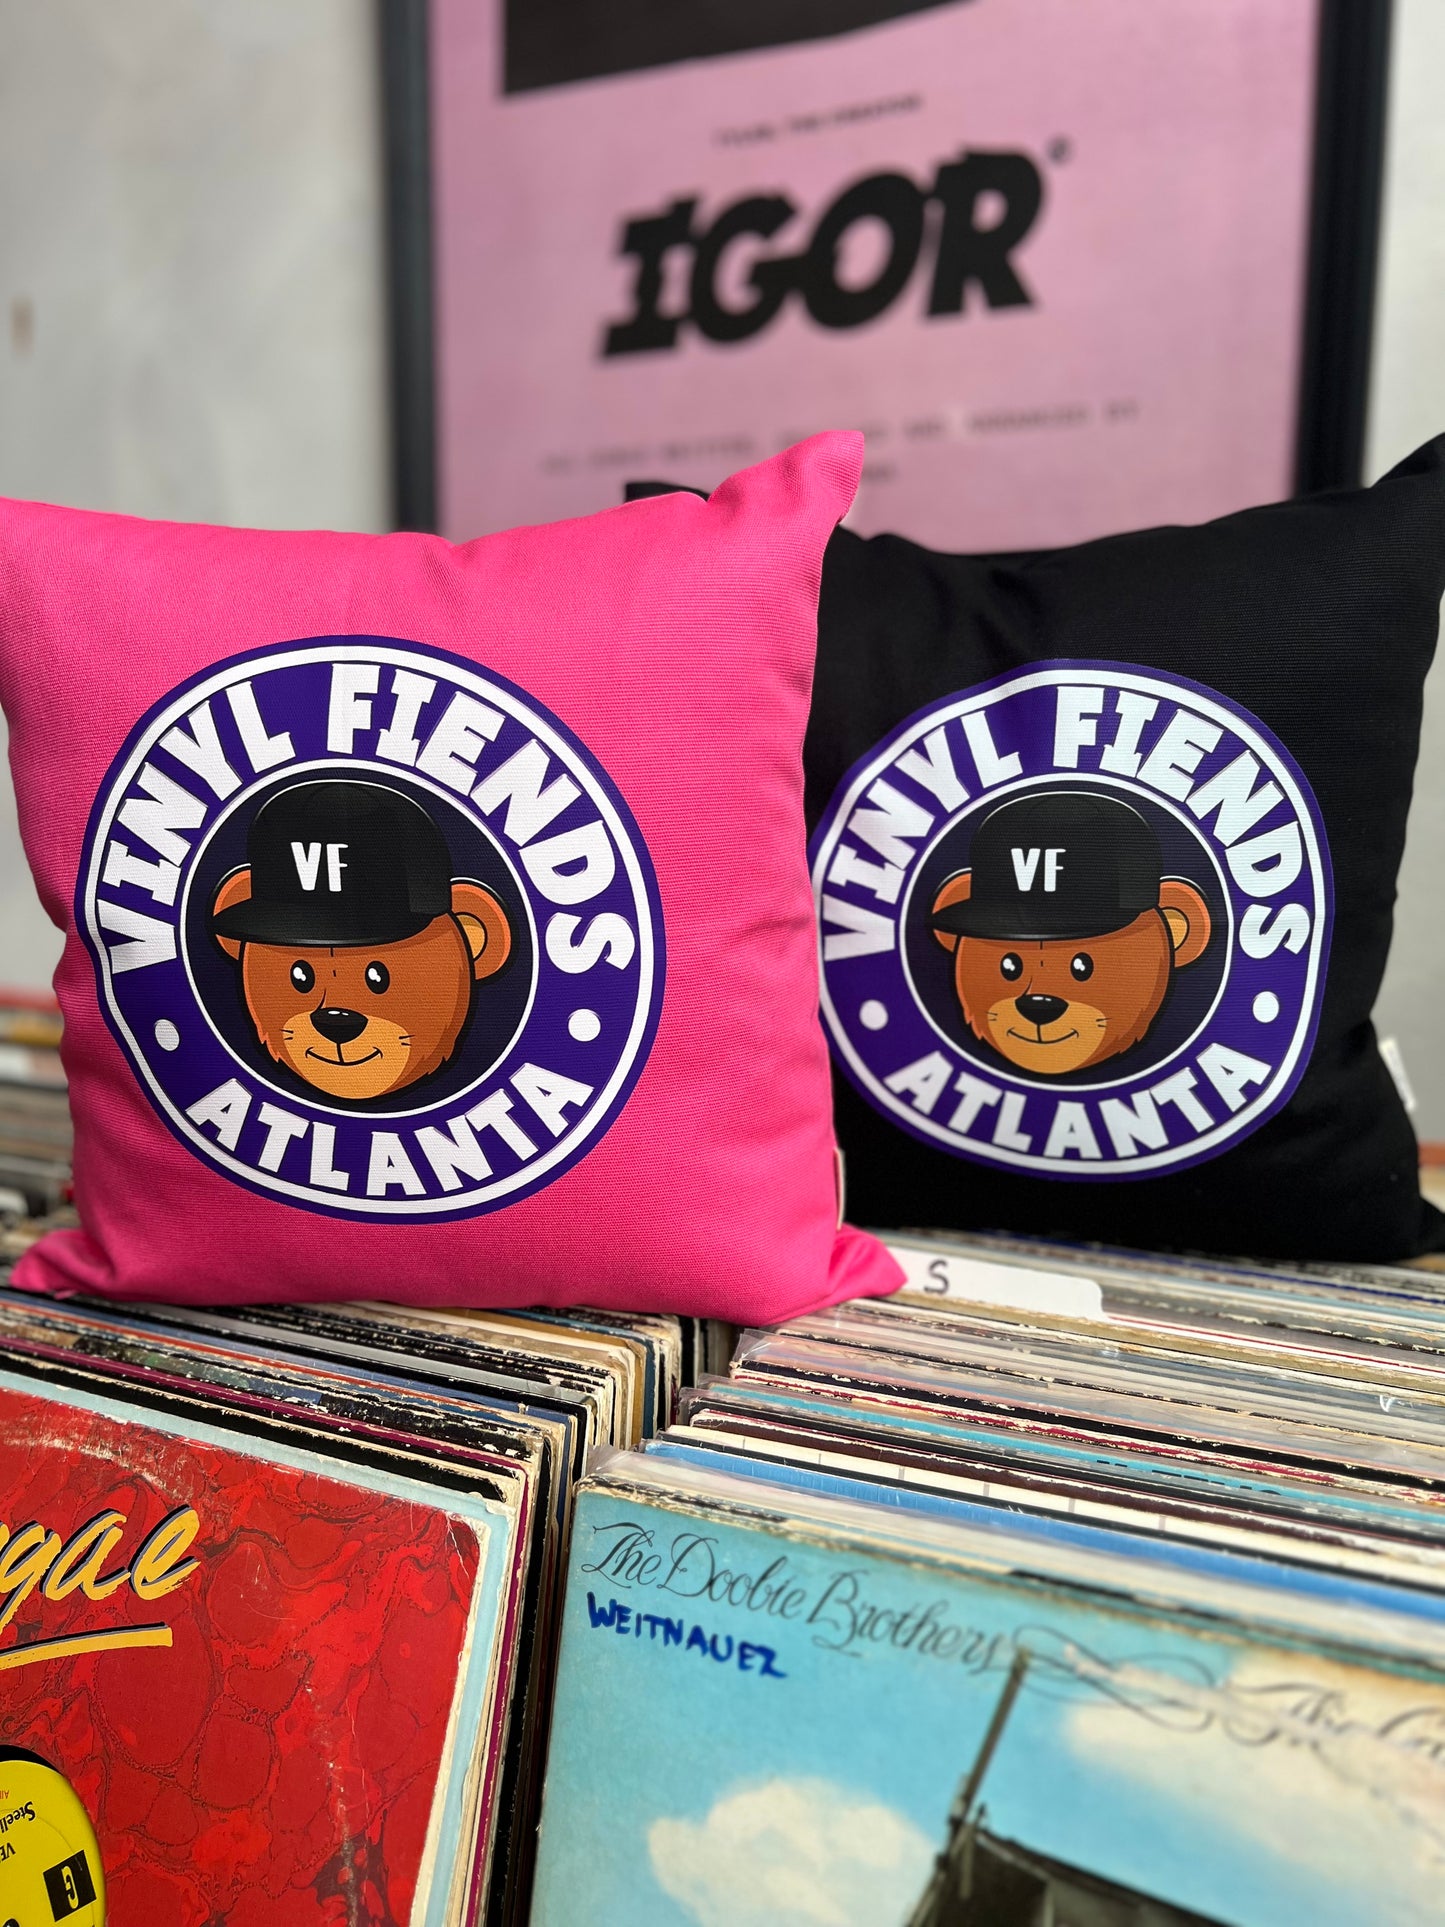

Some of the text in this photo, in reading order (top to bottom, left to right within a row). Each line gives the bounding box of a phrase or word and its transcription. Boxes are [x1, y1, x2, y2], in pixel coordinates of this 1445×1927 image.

[599, 144, 1044, 358] IGOR
[97, 662, 636, 975] VINYL FIENDS
[290, 841, 350, 893] VF
[822, 686, 1311, 961] VINYL FIENDS
[1010, 847, 1067, 893] VF
[185, 1062, 594, 1197] ATLANTA
[884, 1042, 1272, 1160] ATLANTA
[924, 1260, 950, 1295] S
[0, 1504, 201, 1635] gae
[580, 1522, 1002, 1676] The Doobie Brothers
